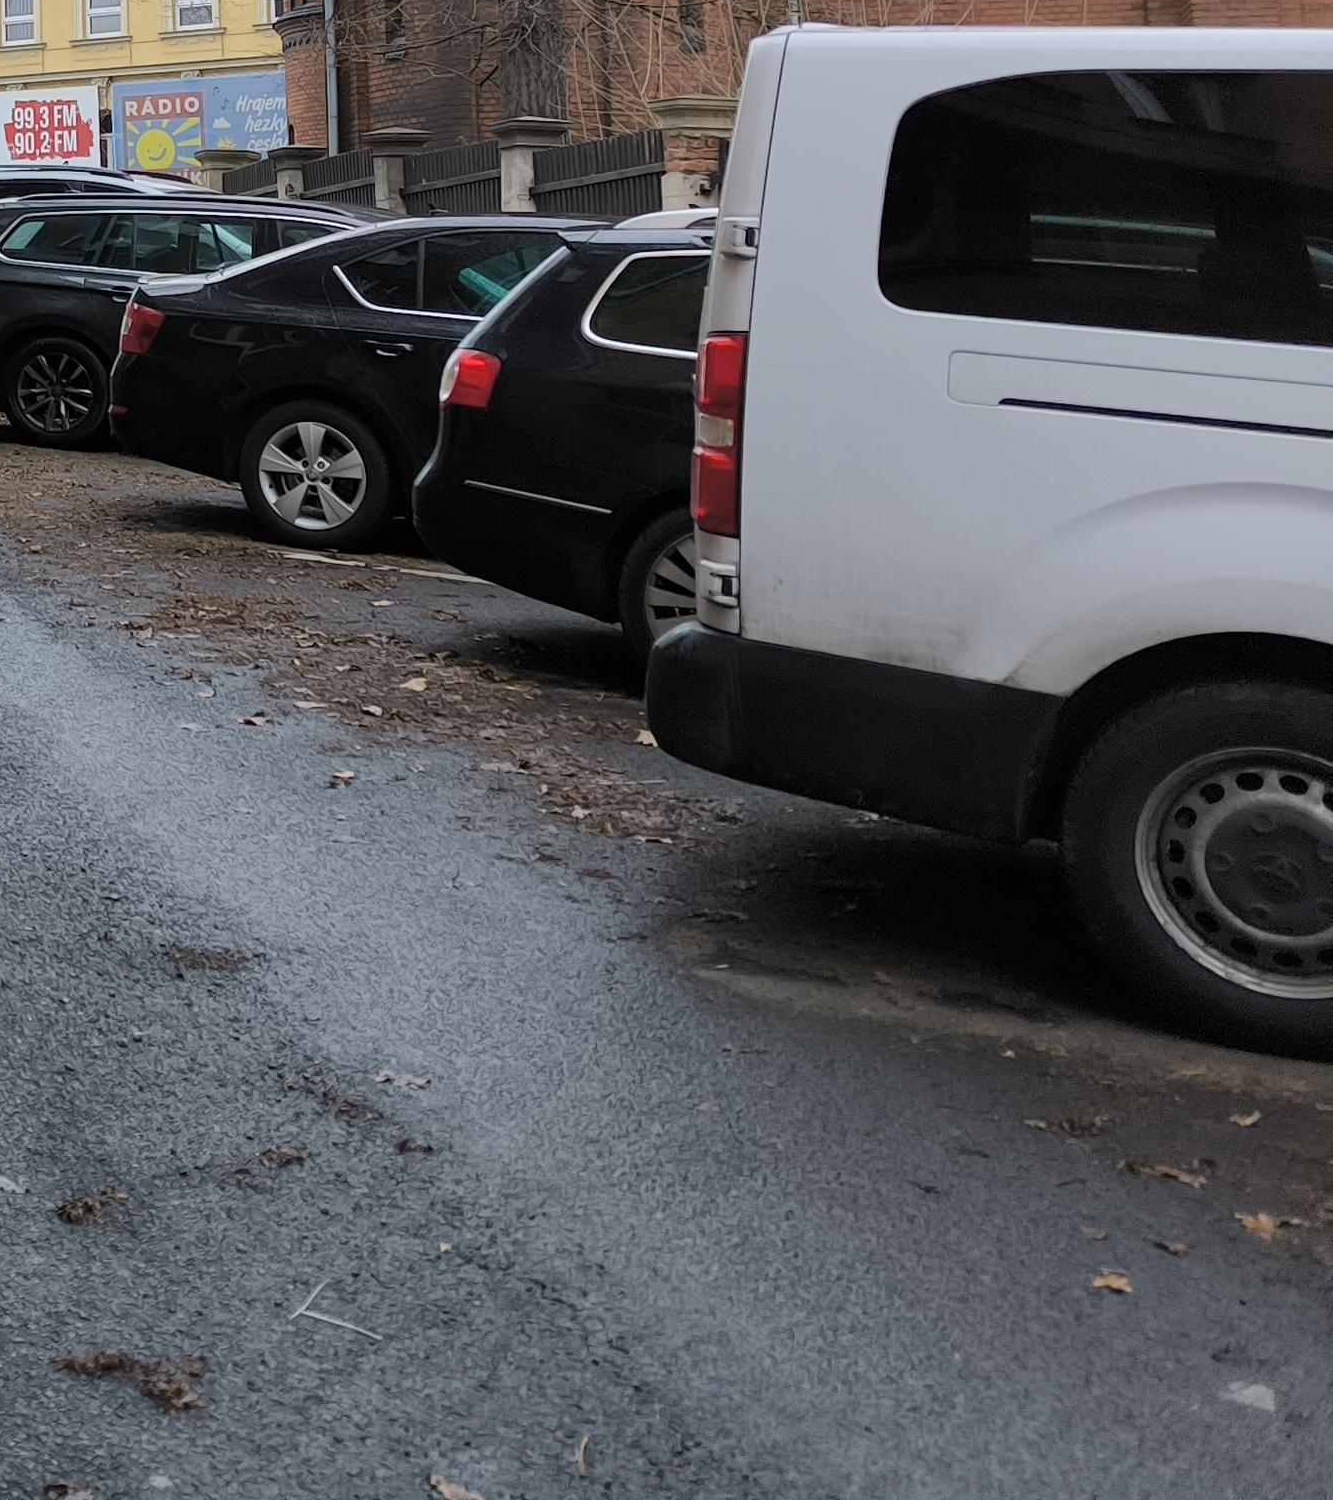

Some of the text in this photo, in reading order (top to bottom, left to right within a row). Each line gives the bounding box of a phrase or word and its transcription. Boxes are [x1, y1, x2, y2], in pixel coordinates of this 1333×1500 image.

[14, 103, 77, 131] 99,3 FM
[124, 96, 200, 117] RÁDIO
[14, 129, 78, 156] 90,2 FM
